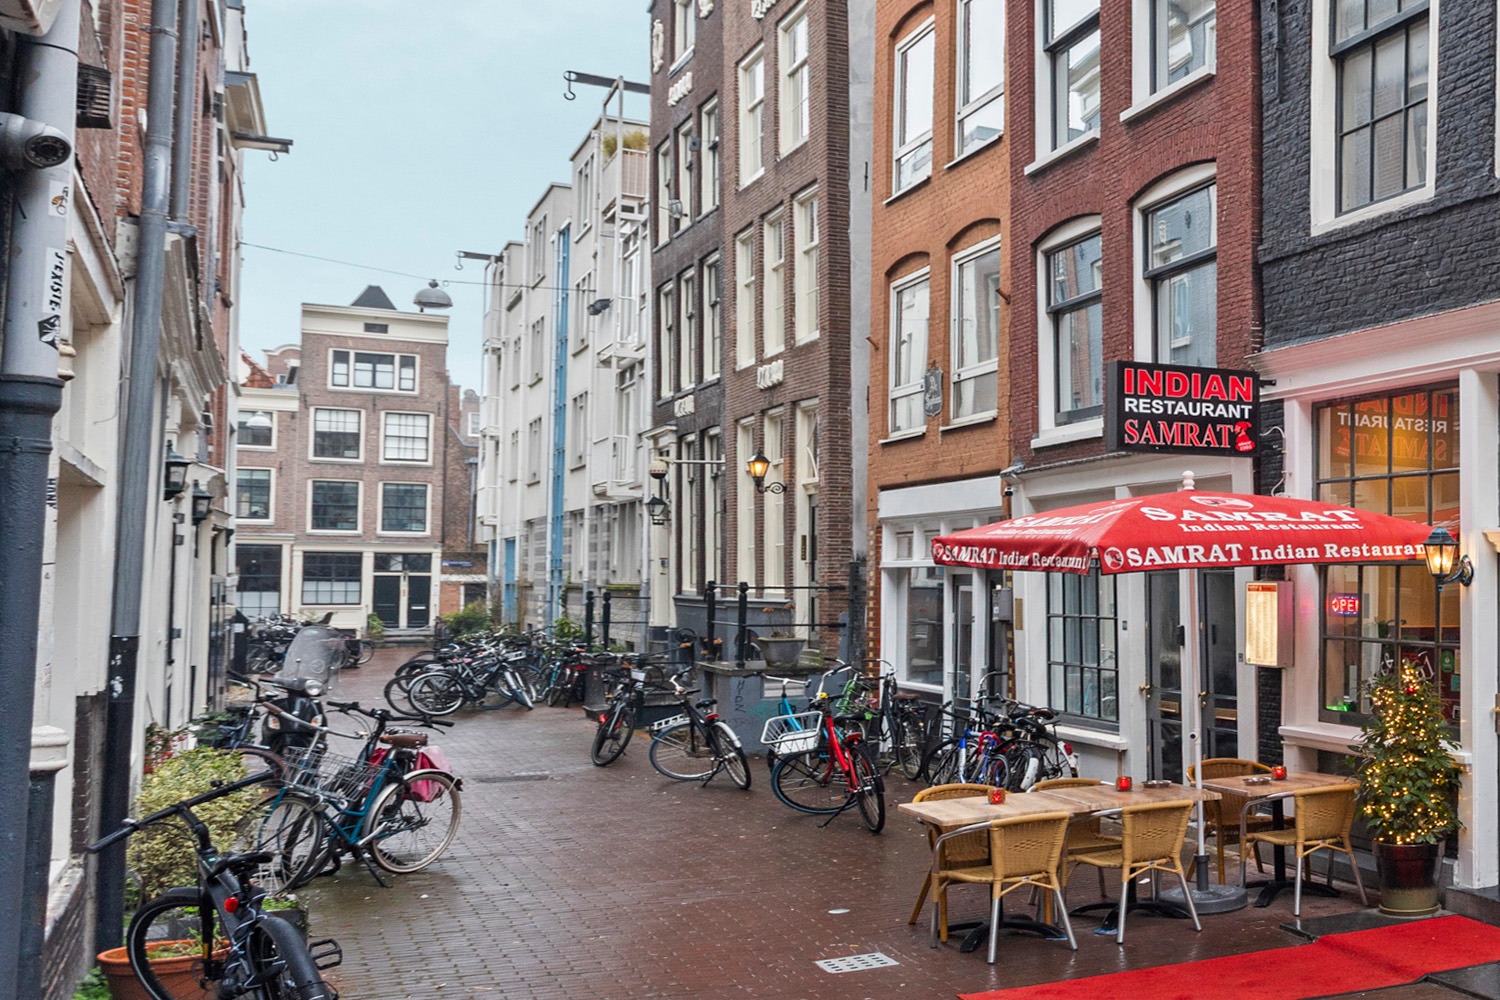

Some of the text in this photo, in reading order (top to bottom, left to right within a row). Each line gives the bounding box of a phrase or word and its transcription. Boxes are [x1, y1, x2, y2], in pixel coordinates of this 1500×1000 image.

[1124, 368, 1253, 402] INDIAN
[1124, 397, 1253, 419] RESTAURANT
[1124, 418, 1234, 449] SAMRAT
[1140, 506, 1359, 523] SAMRAT
[1179, 522, 1364, 532] Indian Restaurant
[942, 545, 998, 564] SAMRAT
[997, 551, 1029, 566] Indian
[1126, 543, 1427, 567] SAMRAT Indian Restauran
